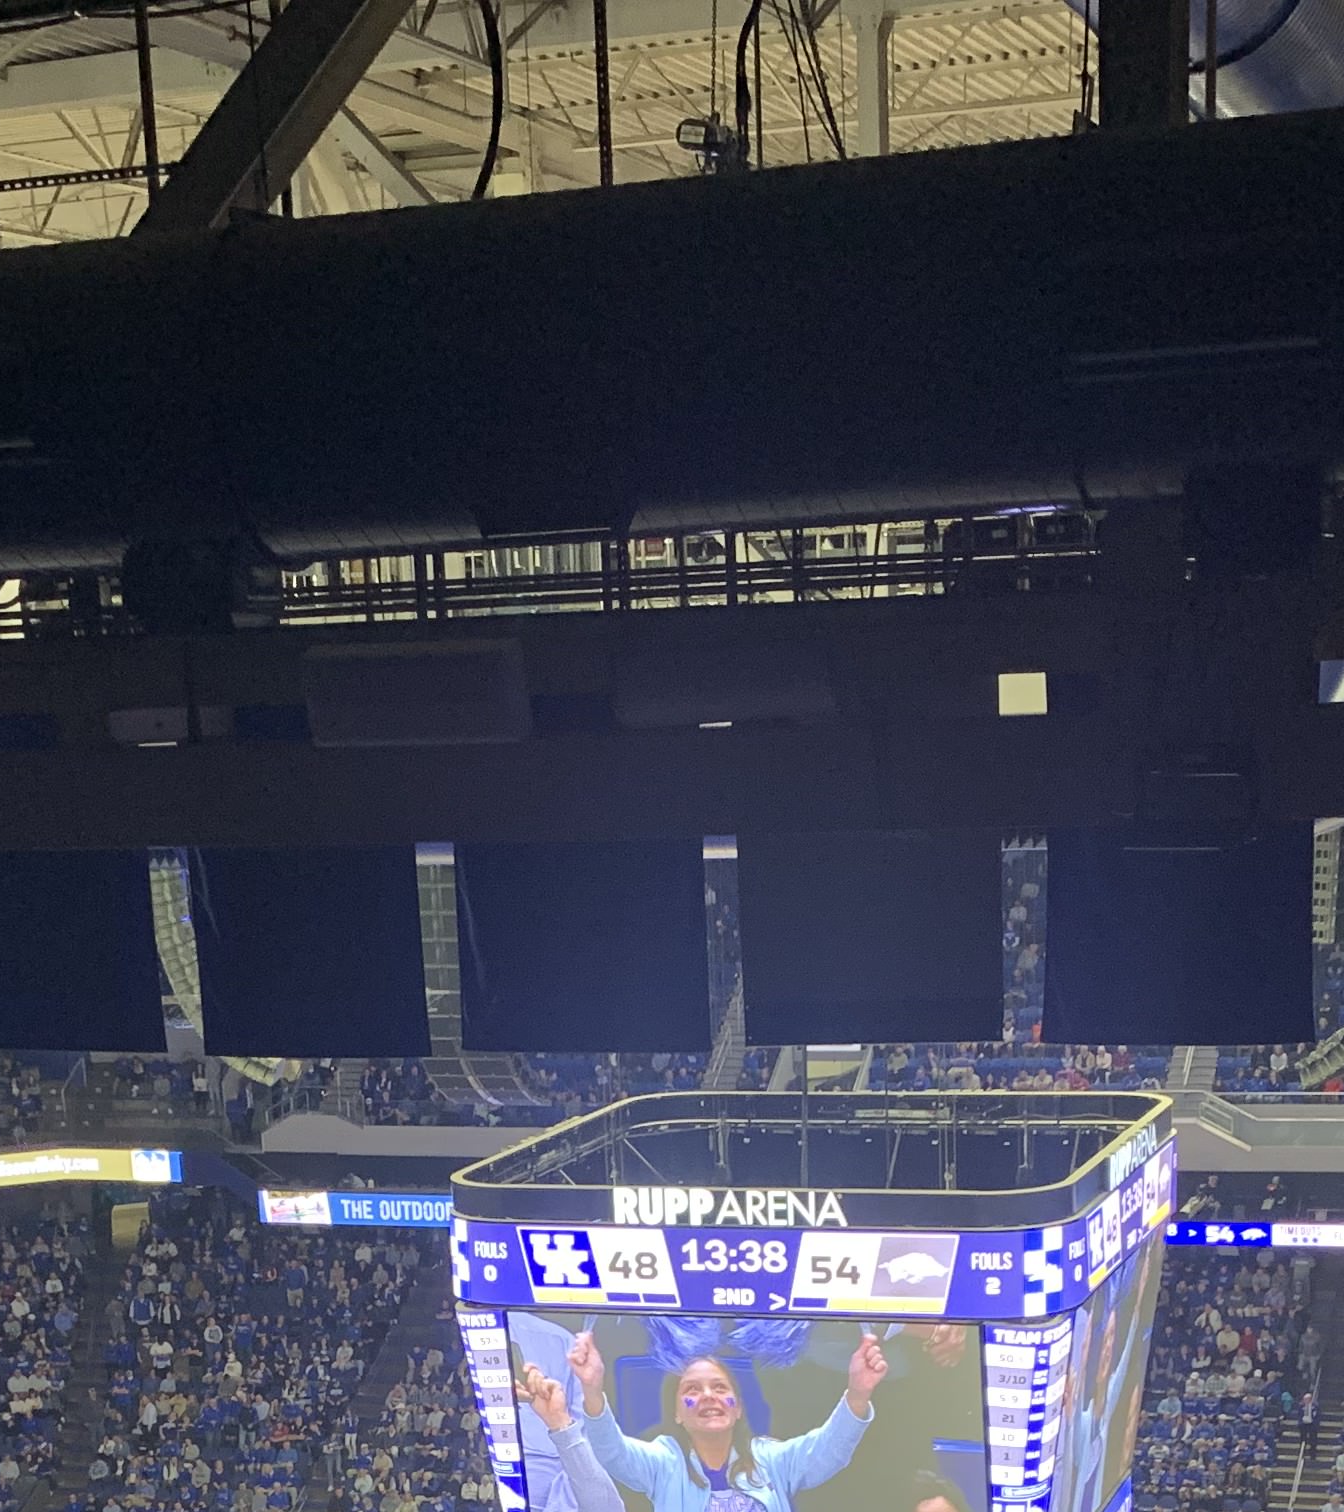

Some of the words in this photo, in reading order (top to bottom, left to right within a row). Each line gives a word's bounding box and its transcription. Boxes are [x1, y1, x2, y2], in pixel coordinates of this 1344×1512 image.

[340, 1199, 375, 1220] THE
[613, 1188, 715, 1225] RUPP
[716, 1190, 848, 1227] ARENA
[474, 1241, 508, 1259] FOULS
[681, 1237, 788, 1273] 13:38
[608, 1251, 658, 1280] 48
[811, 1255, 861, 1285] 54
[971, 1252, 1013, 1270] FOULS
[483, 1265, 498, 1282] 0
[985, 1276, 1001, 1295] 2
[713, 1287, 755, 1306] 2ND
[993, 1329, 1041, 1345] TEAM
